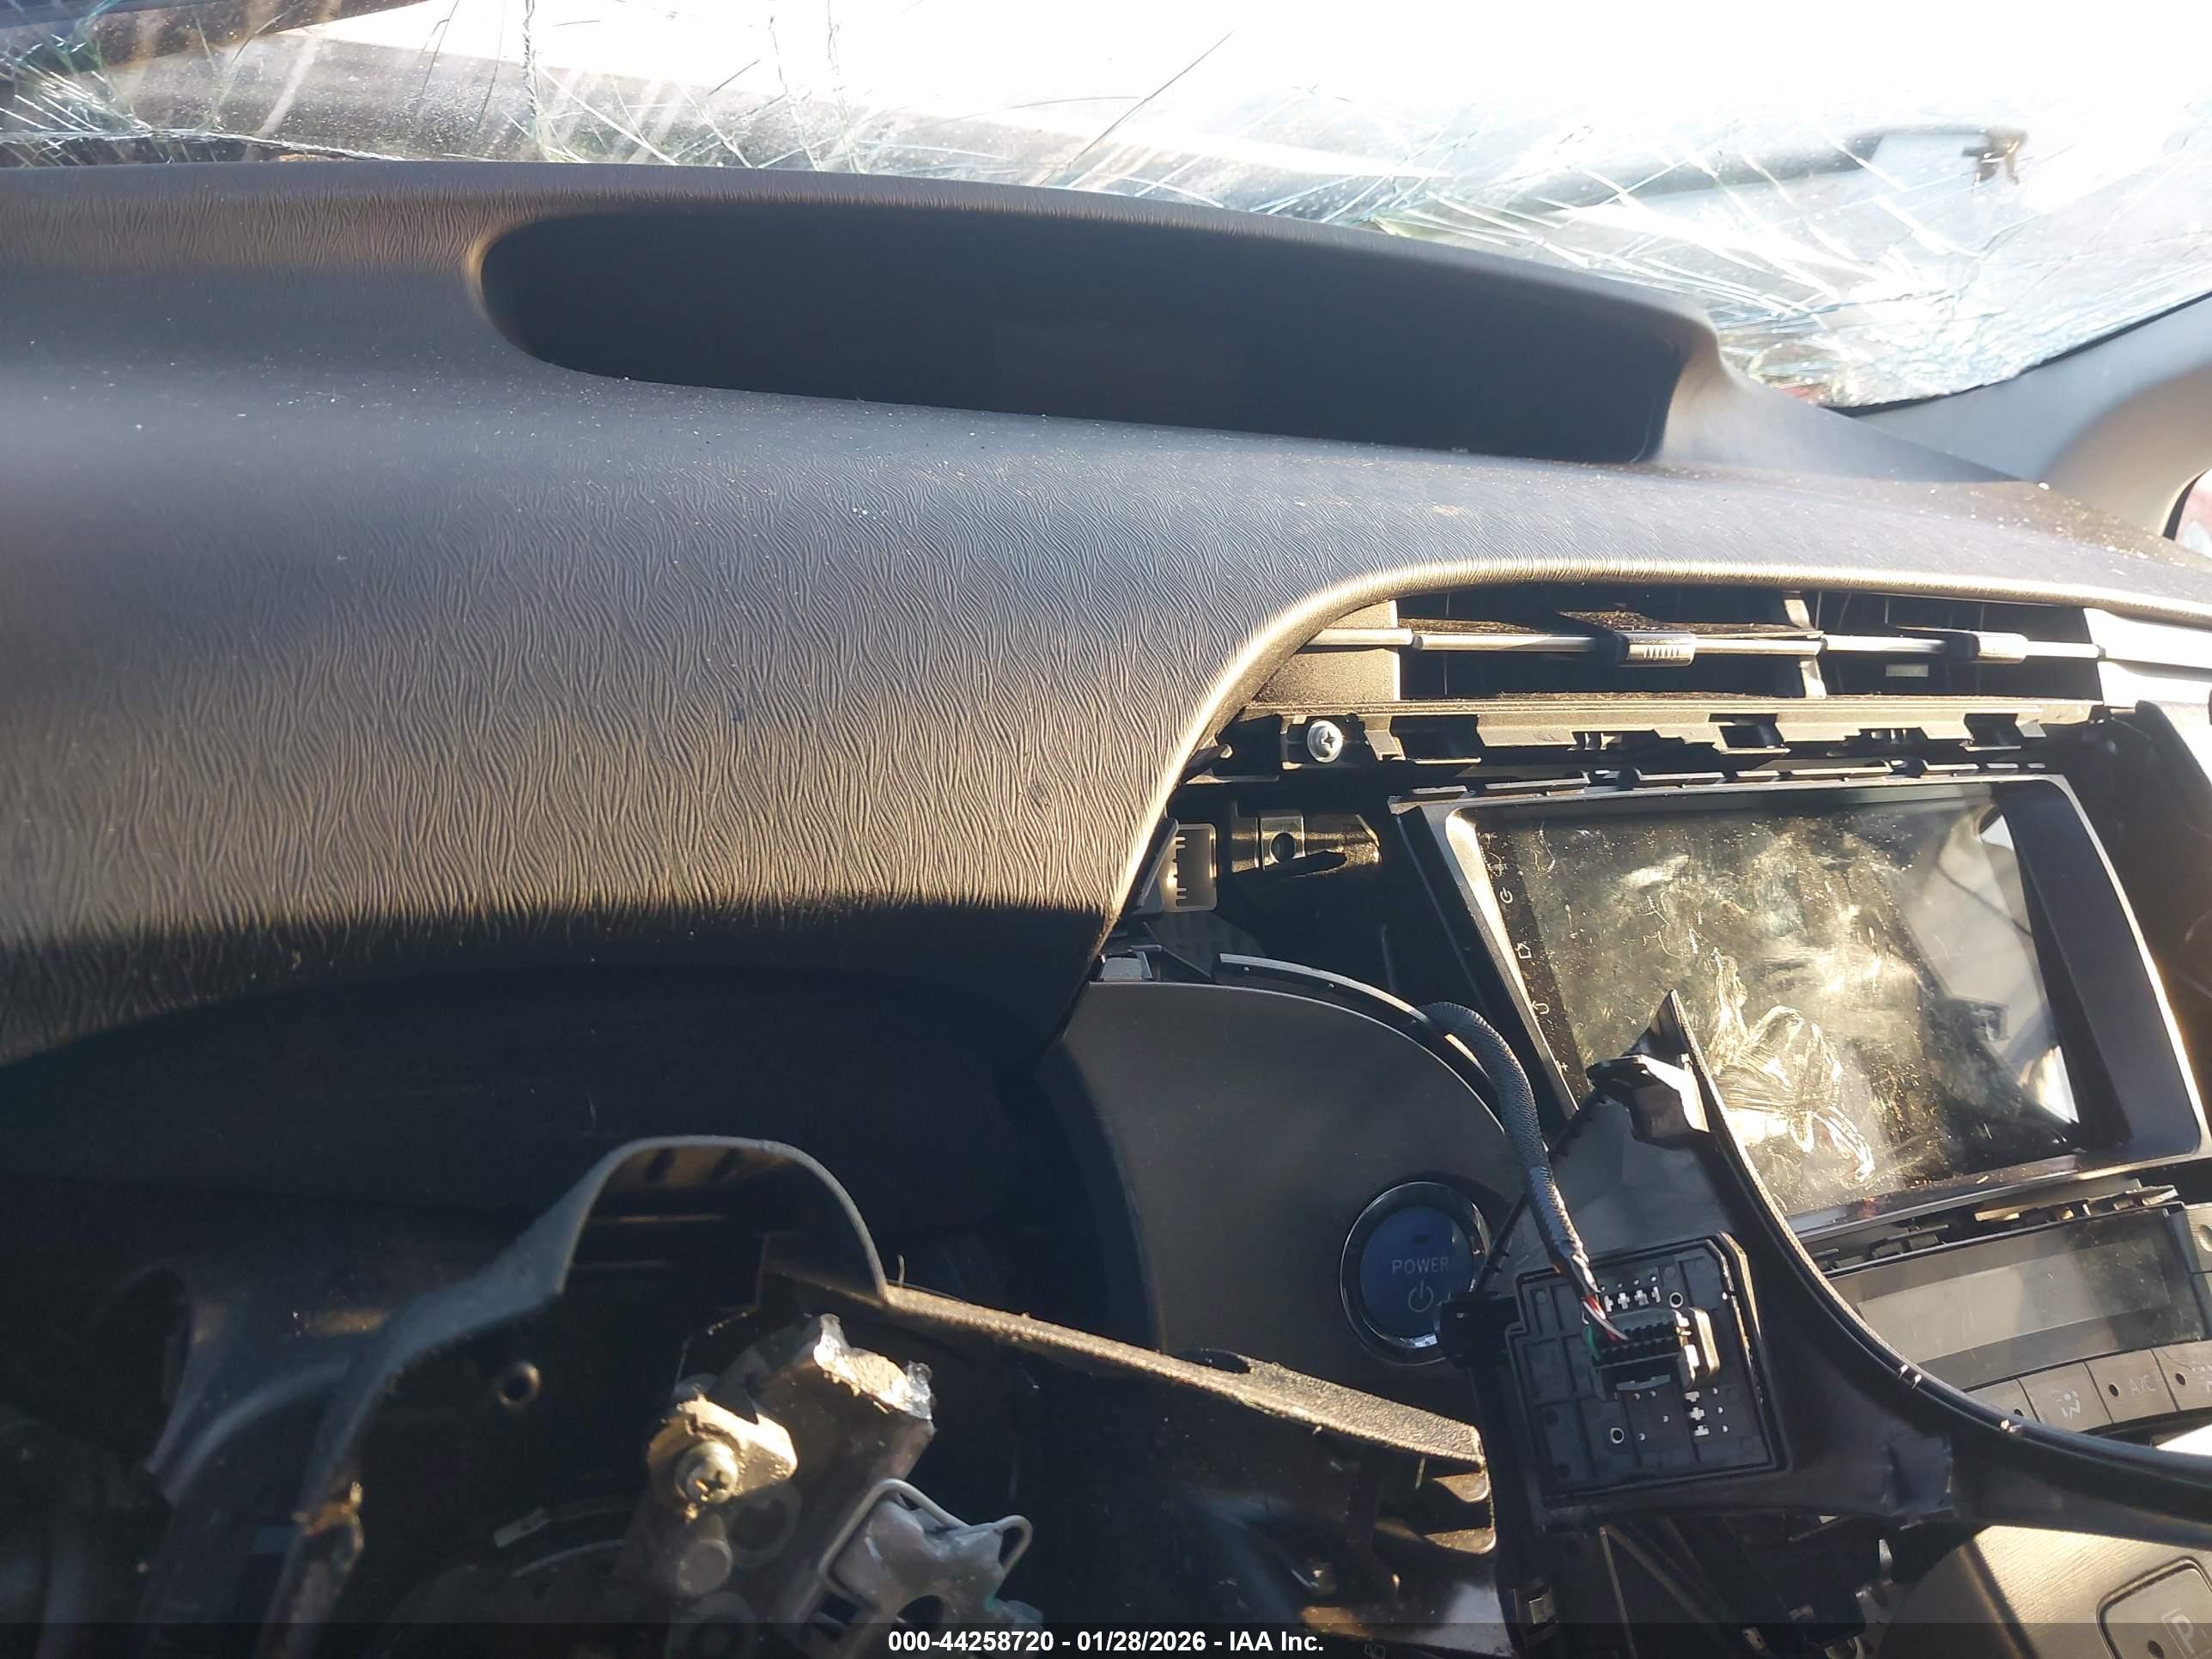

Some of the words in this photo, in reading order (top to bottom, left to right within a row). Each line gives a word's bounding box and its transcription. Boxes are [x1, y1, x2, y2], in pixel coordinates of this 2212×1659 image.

[1392, 1256, 1449, 1274] POWER
[2130, 1374, 2156, 1395] A/C
[2171, 1613, 2196, 1656] P
